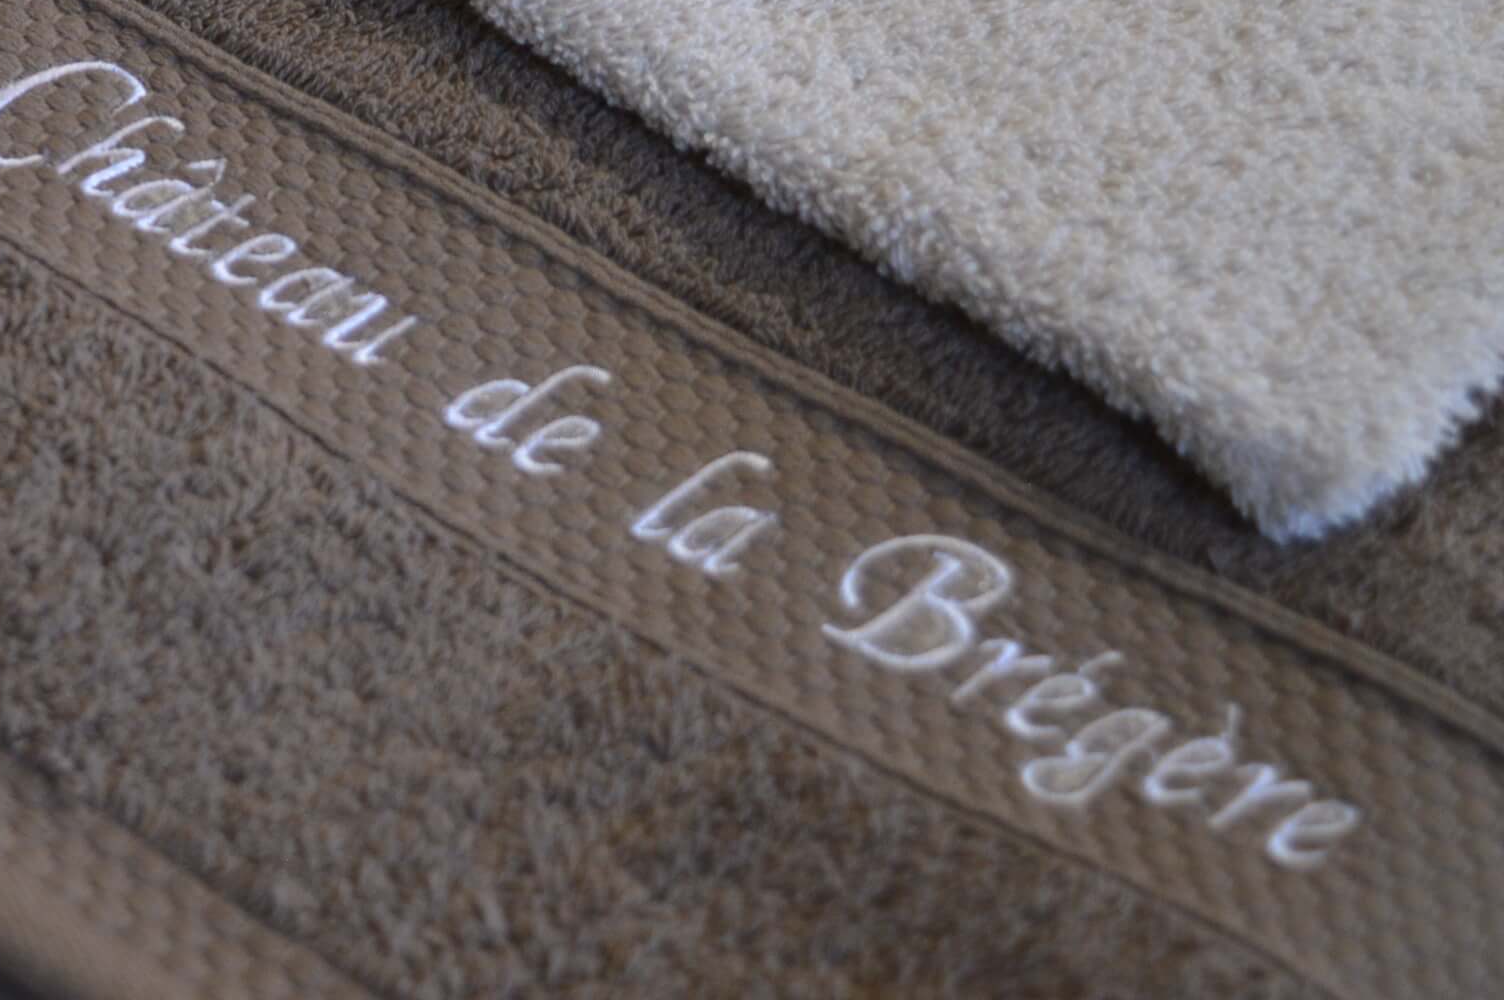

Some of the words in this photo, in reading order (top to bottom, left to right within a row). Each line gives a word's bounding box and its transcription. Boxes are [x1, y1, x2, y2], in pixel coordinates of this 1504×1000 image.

[442, 365, 613, 474] de
[630, 451, 780, 575] la
[821, 533, 1360, 868] Brégère
